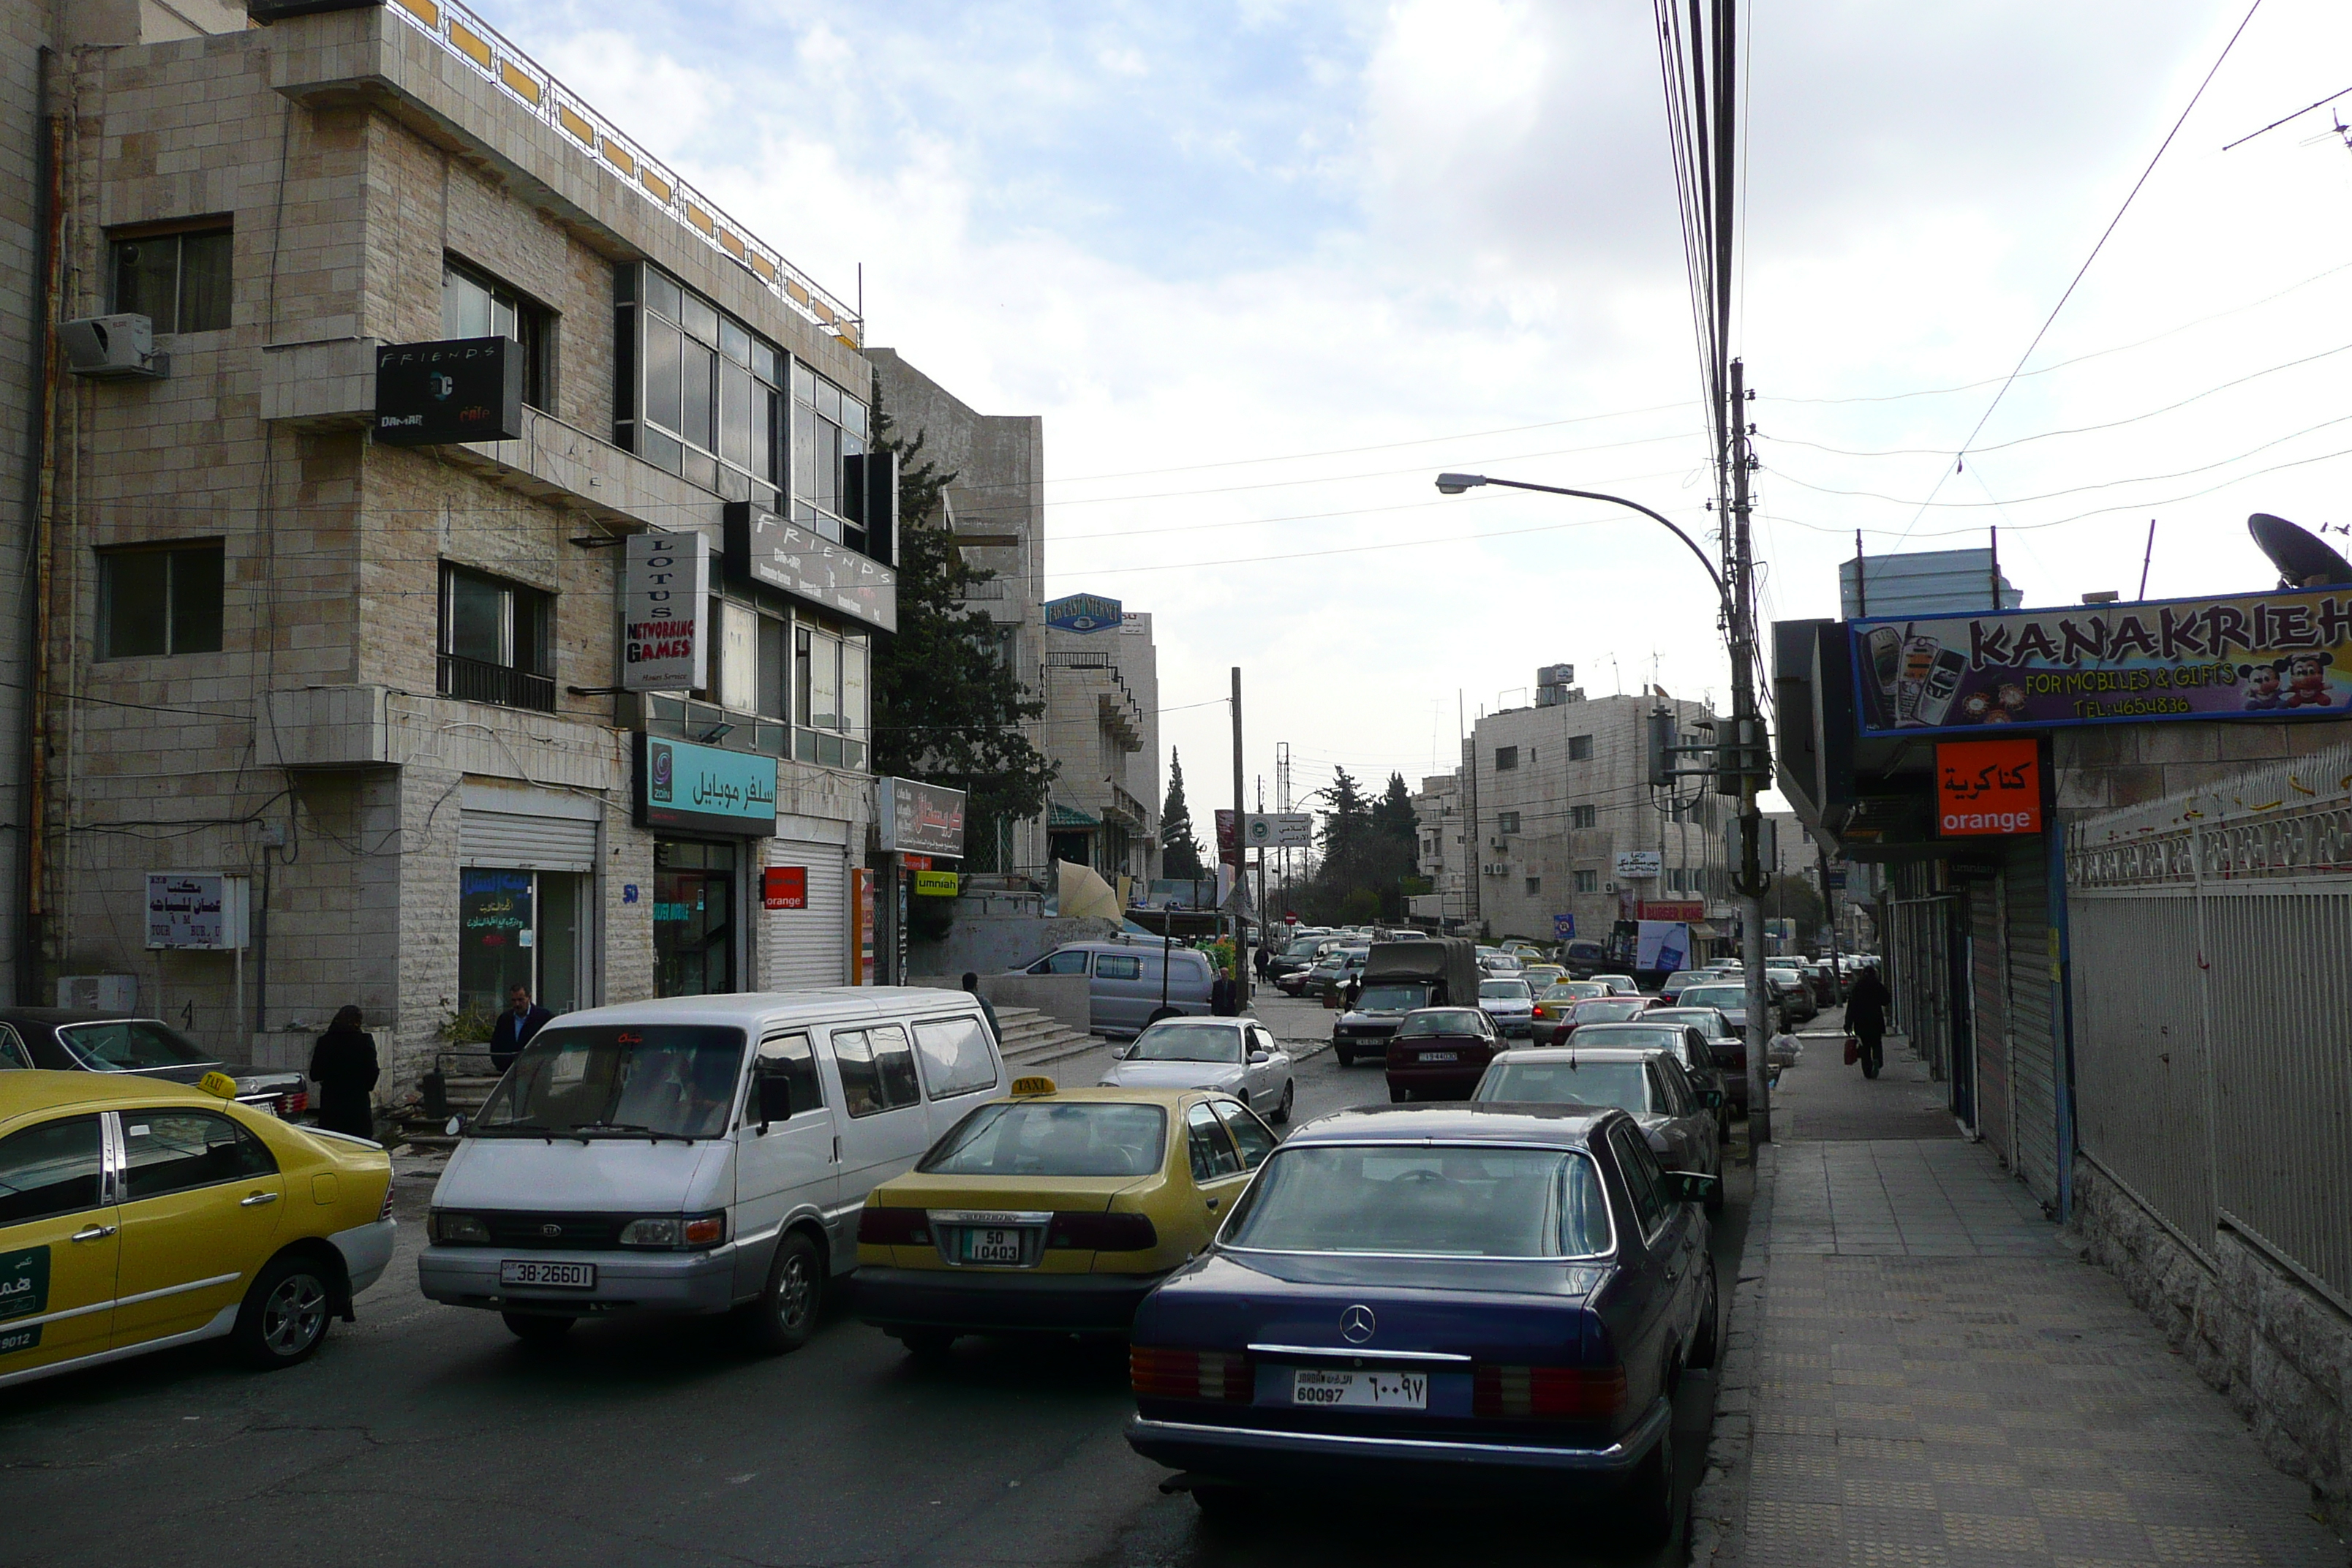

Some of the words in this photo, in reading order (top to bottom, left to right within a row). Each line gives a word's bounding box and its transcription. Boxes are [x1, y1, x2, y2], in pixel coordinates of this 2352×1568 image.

[381, 347, 494, 367] FRIENDS
[381, 415, 423, 427] DAMAR
[756, 513, 891, 584] FRIENDS
[647, 540, 674, 619] LOTUS
[1049, 606, 1062, 623] FAR
[1064, 598, 1082, 618] EAST
[1084, 597, 1118, 622] INTERNET
[627, 619, 694, 640] NETWORKING
[1970, 597, 2352, 671] KANAKRIEH
[627, 638, 692, 664] GAMES
[663, 672, 687, 682] Service
[2026, 674, 2061, 694] FOR
[2066, 668, 2149, 693] MOBILES
[2155, 669, 2170, 687] &
[2173, 663, 2234, 687] GIFTS
[693, 771, 739, 809] موبايل
[1945, 761, 2032, 800] كناكرية
[744, 775, 774, 811] سلفر
[1943, 812, 2031, 832] orange
[167, 879, 201, 896] مكتب
[919, 876, 956, 889] umniah
[193, 898, 221, 915] عمان
[766, 897, 802, 908] orange
[205, 1074, 223, 1092] TAXI
[1016, 1077, 1045, 1091] TAXI
[543, 1226, 558, 1235] KIA
[987, 1231, 1005, 1244] 50
[974, 1245, 1017, 1259] 10403
[1297, 1372, 1325, 1384] JORDAN
[1297, 1387, 1344, 1403] 60097
[1368, 1376, 1424, 1403] ٦٠٠٩٧
